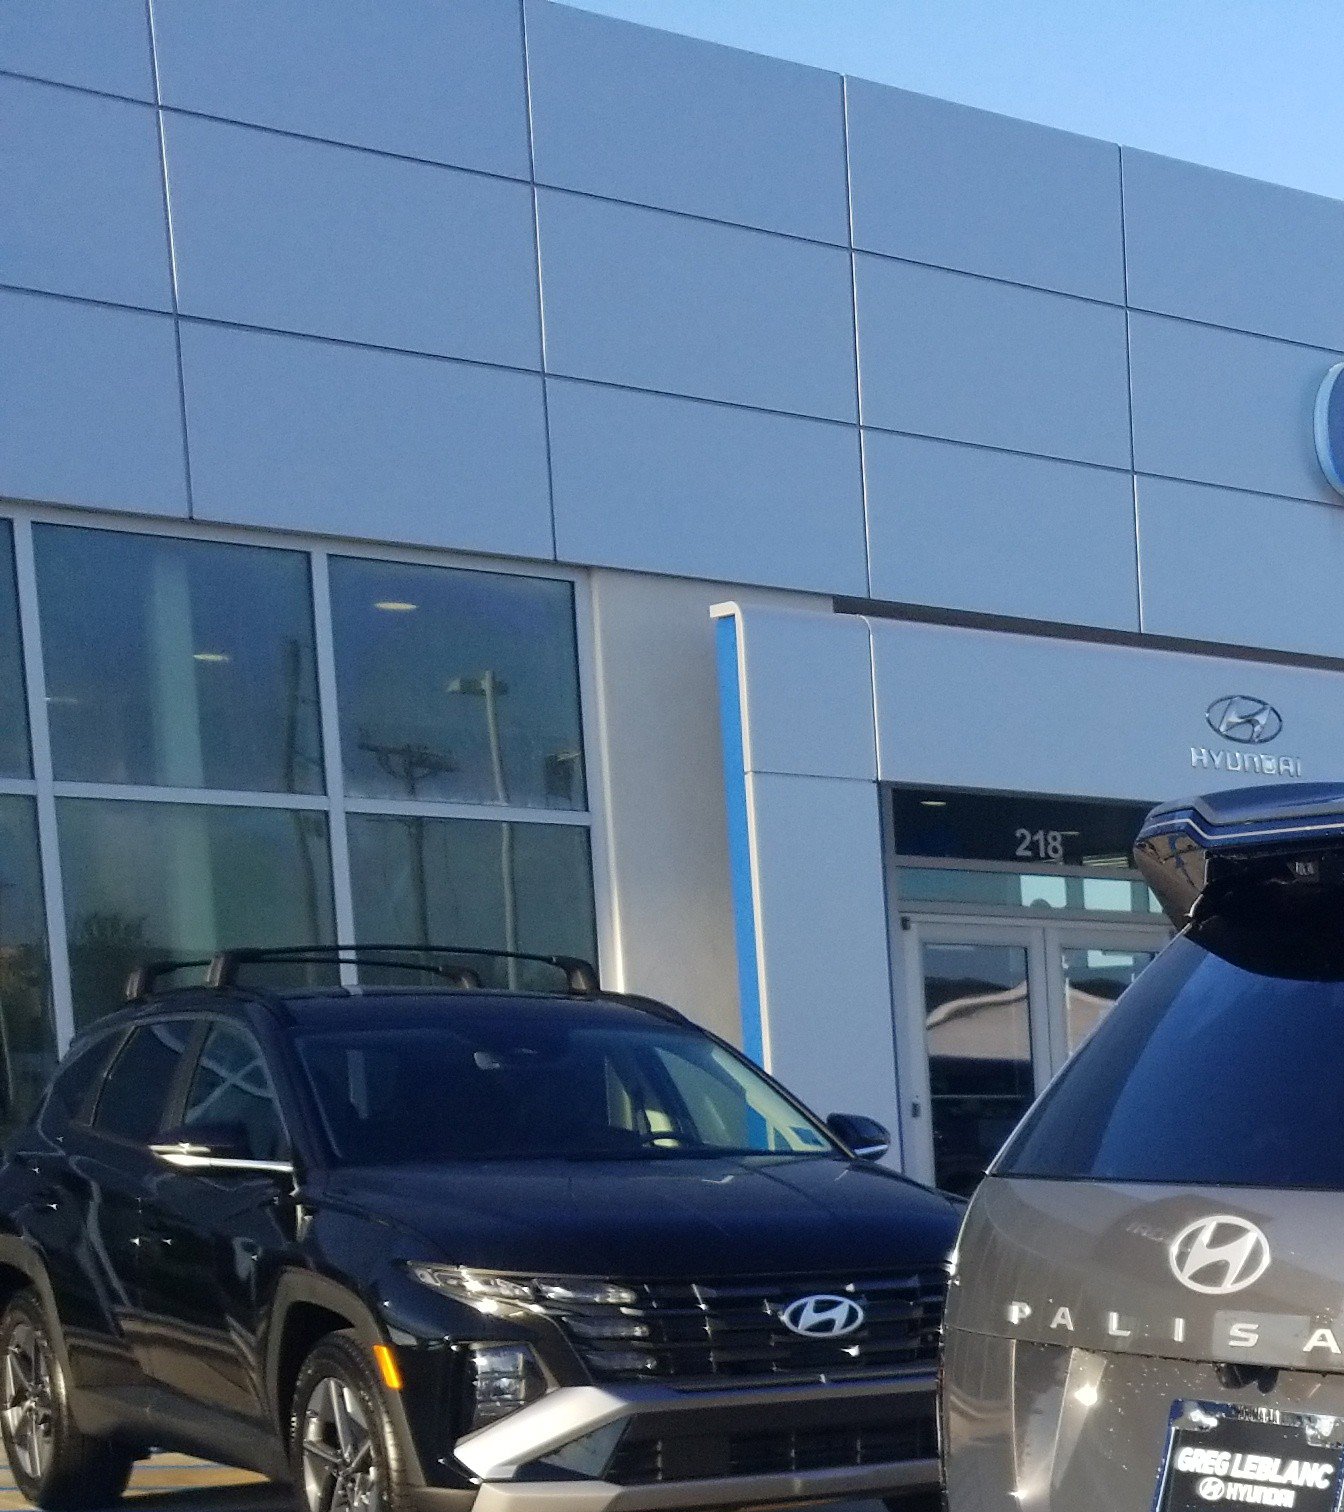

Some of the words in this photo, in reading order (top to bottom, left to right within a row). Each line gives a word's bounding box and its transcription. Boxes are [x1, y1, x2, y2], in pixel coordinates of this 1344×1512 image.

[1190, 747, 1301, 777] HYUNDAI
[1014, 827, 1064, 860] 218
[1177, 1447, 1231, 1476] GREG
[1232, 1453, 1334, 1489] LEBLANC
[1226, 1482, 1296, 1508] HYUNDAI
